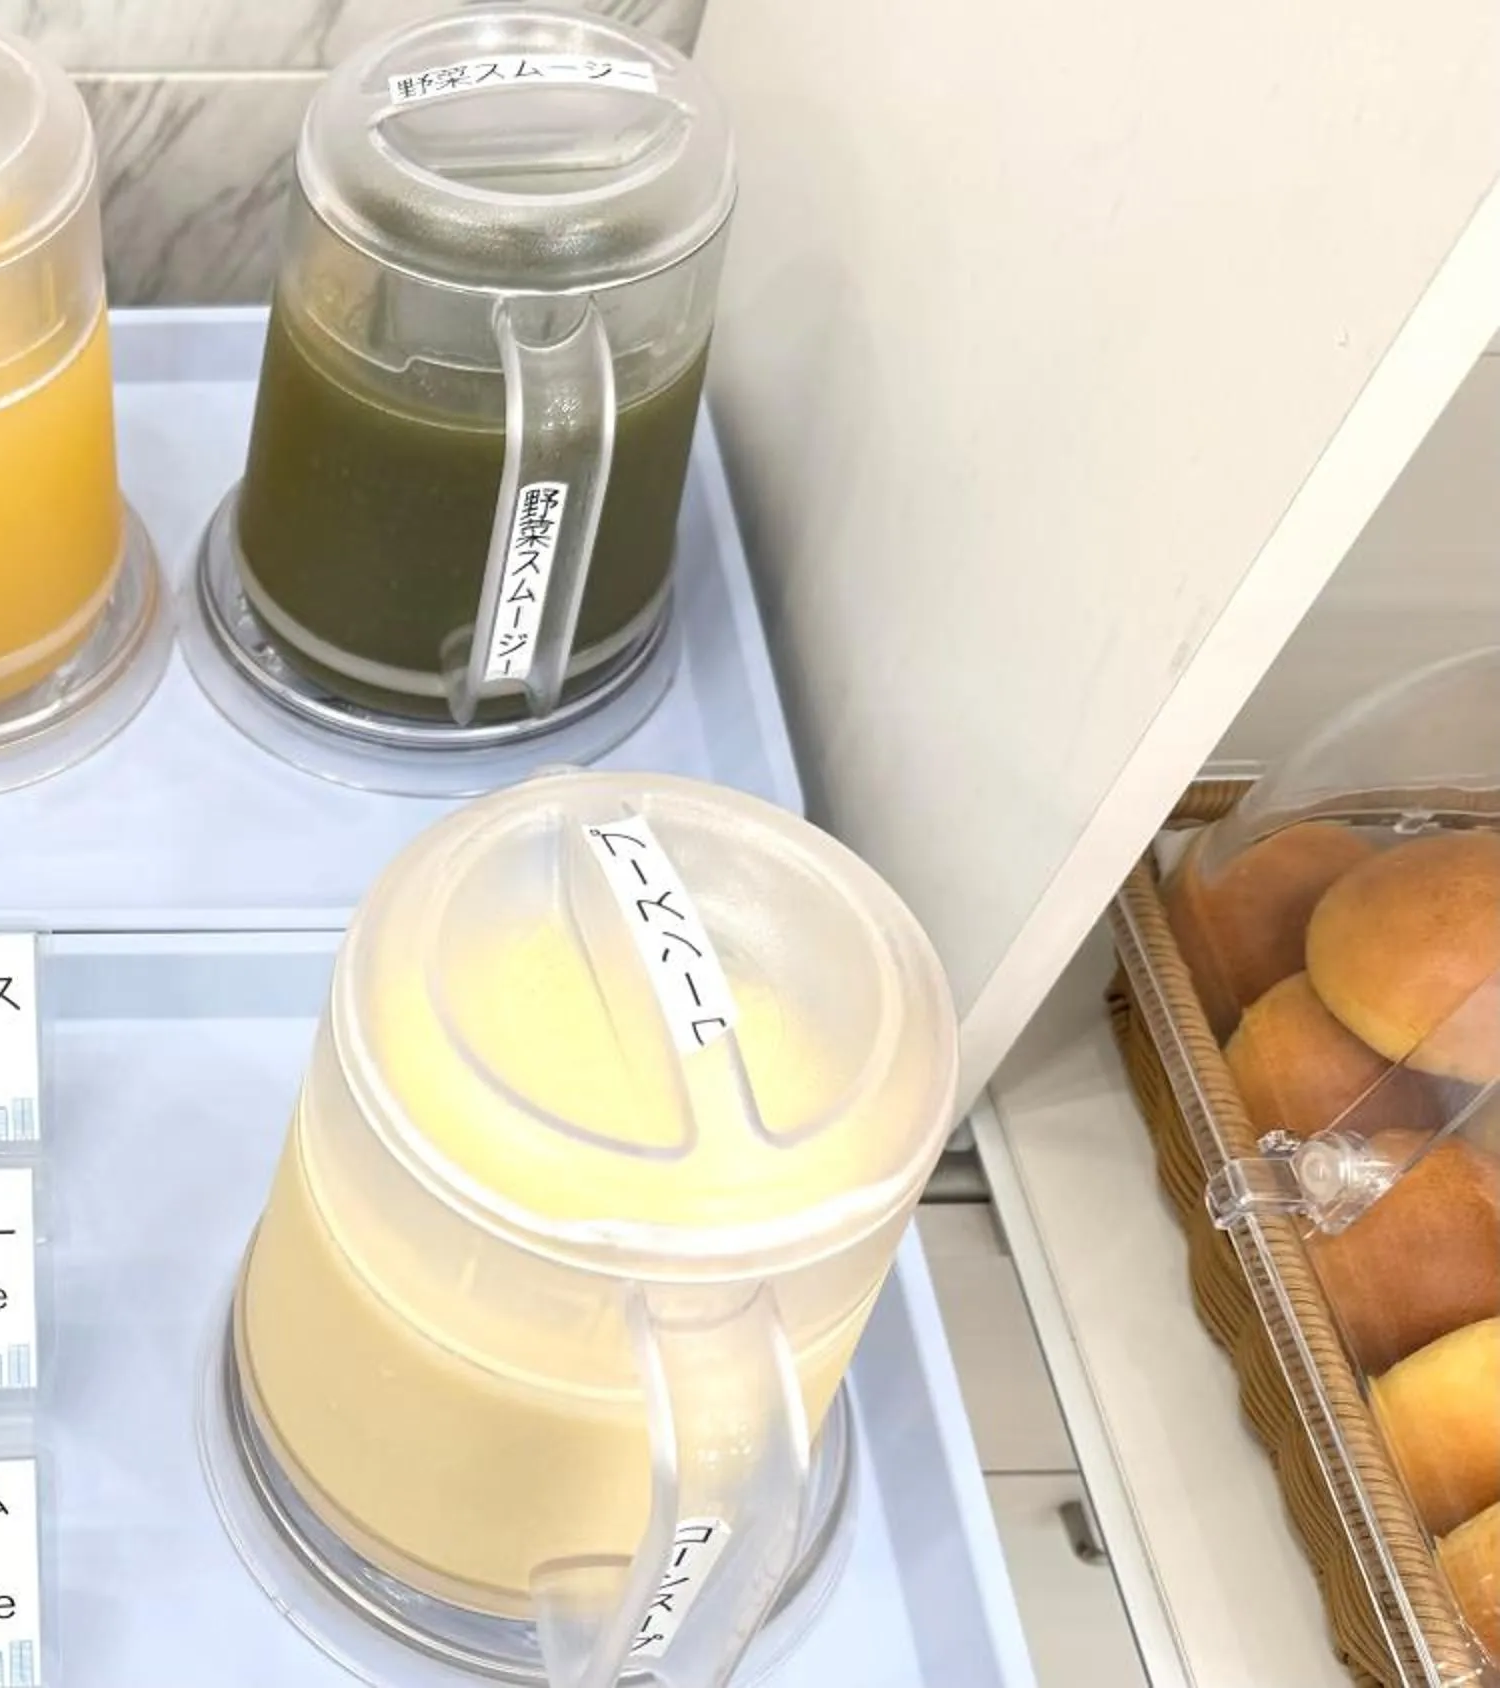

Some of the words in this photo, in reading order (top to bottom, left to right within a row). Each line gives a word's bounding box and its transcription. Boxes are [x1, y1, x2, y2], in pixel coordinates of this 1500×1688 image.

[396, 58, 650, 99] 野菜スムージー
[497, 487, 560, 676] 野菜スムージー
[588, 828, 728, 1047] コーンスープ
[630, 1525, 714, 1653] コーンスープ
